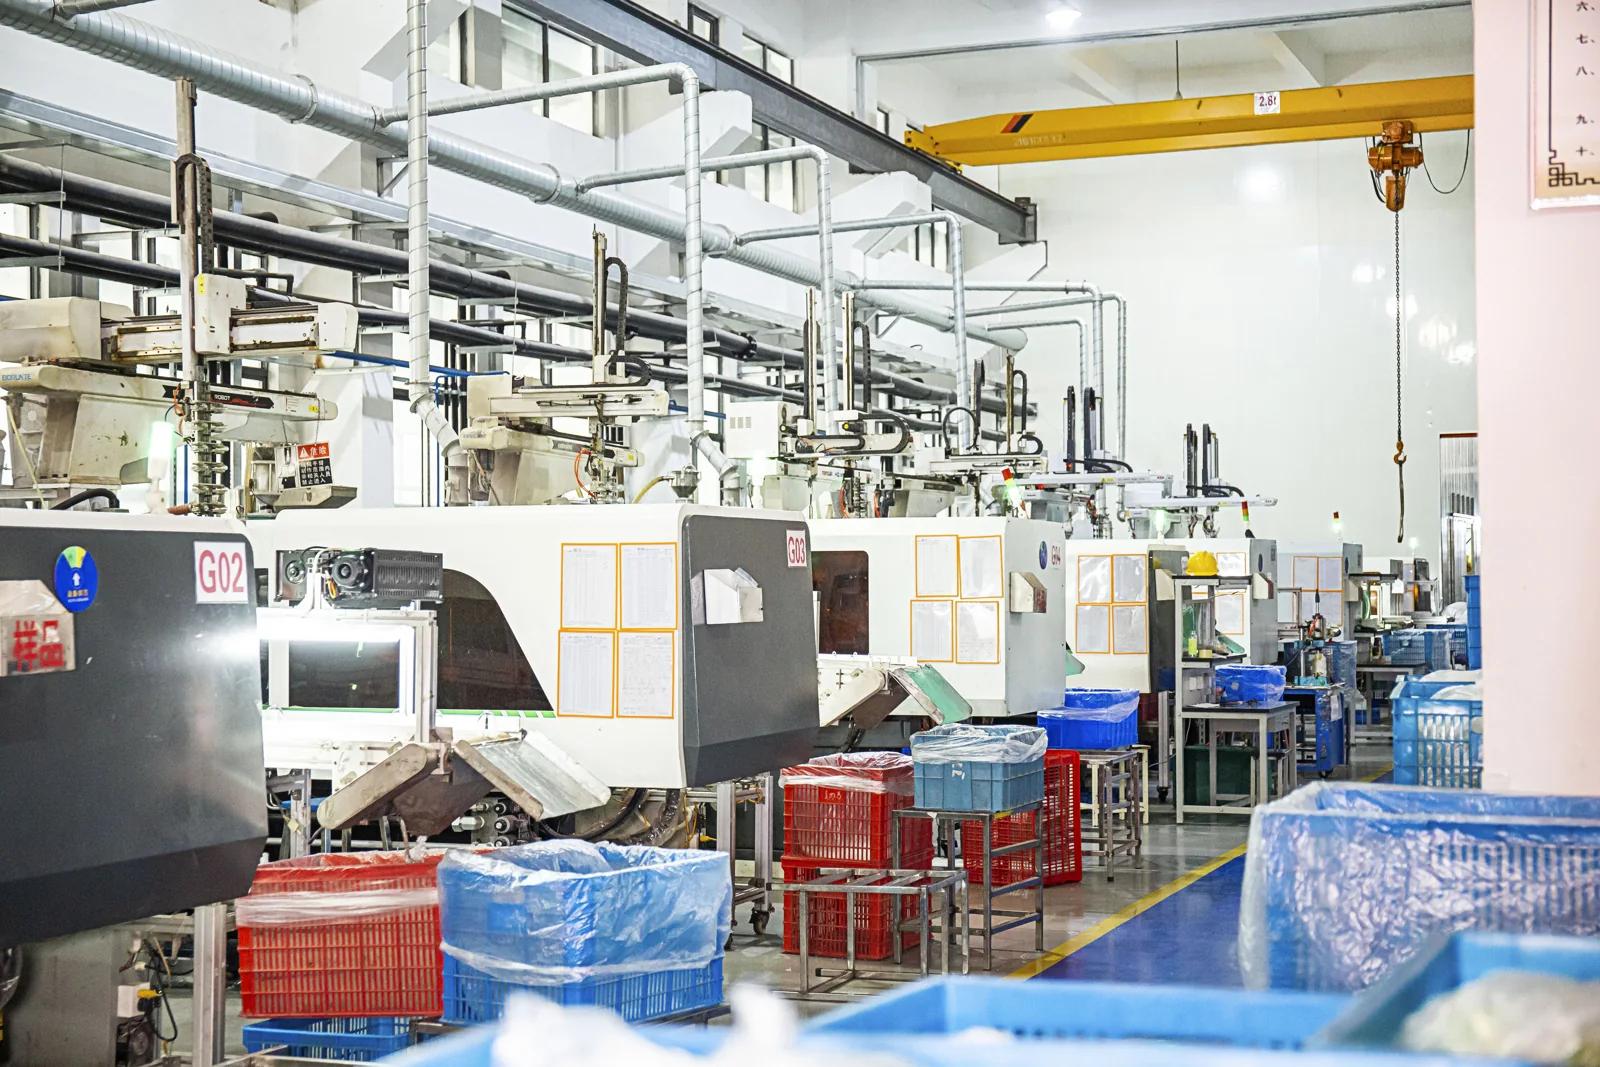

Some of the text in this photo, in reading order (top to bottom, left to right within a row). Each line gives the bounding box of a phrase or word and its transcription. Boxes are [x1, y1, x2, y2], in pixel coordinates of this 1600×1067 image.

[1576, 1, 1595, 12] 六、
[1576, 34, 1595, 44] 七、
[1576, 66, 1595, 76] 八、
[1259, 95, 1277, 107] 2.8t
[1576, 114, 1595, 125] 九、
[1576, 146, 1595, 157] 十、
[788, 536, 805, 563] G03
[199, 549, 244, 593] G02
